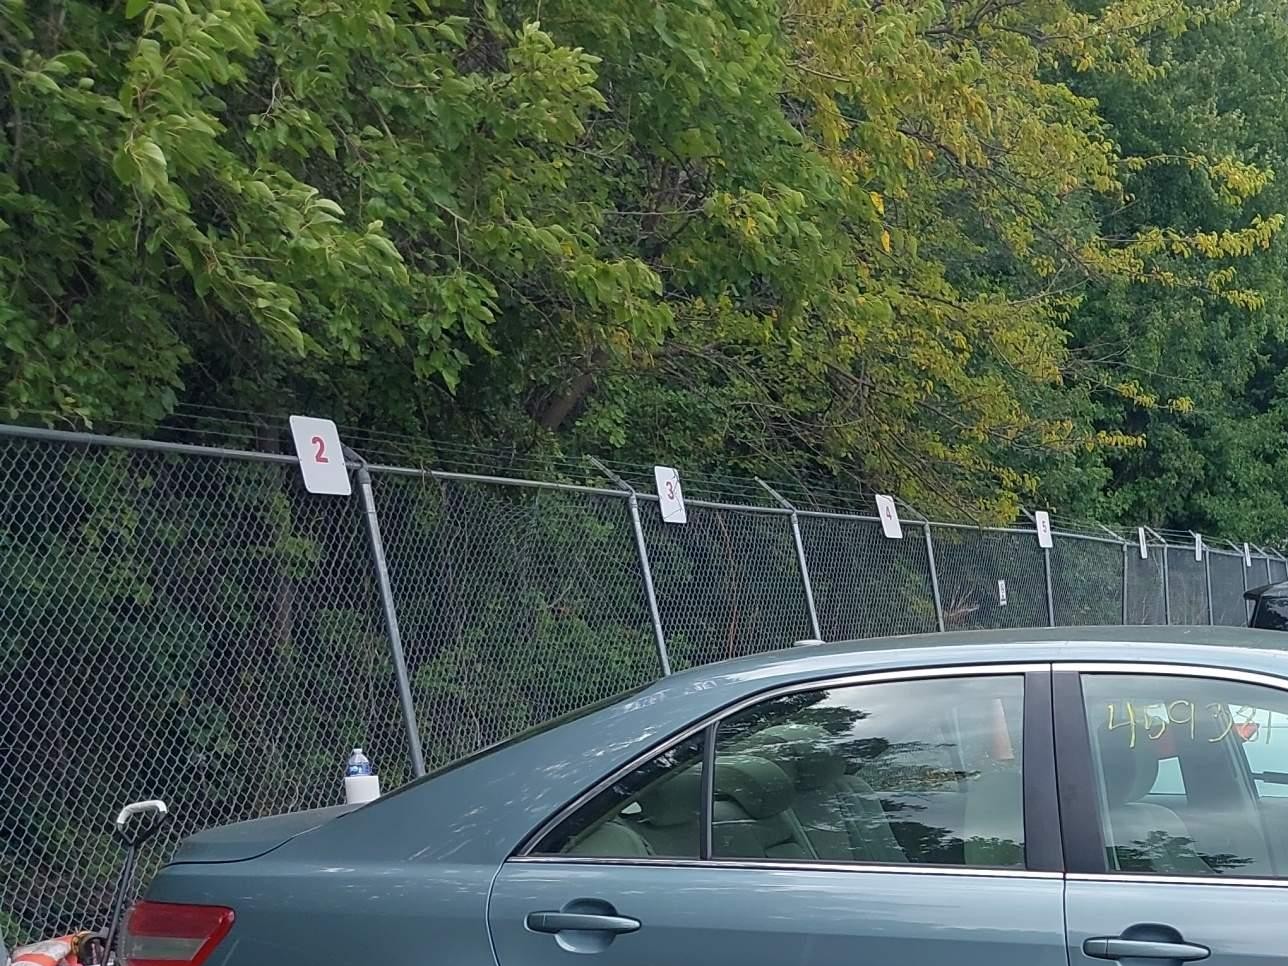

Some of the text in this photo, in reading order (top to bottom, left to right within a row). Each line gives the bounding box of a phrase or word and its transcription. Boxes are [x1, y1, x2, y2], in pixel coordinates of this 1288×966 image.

[311, 436, 329, 463] 2
[665, 481, 675, 500] 3
[885, 506, 893, 520] 4
